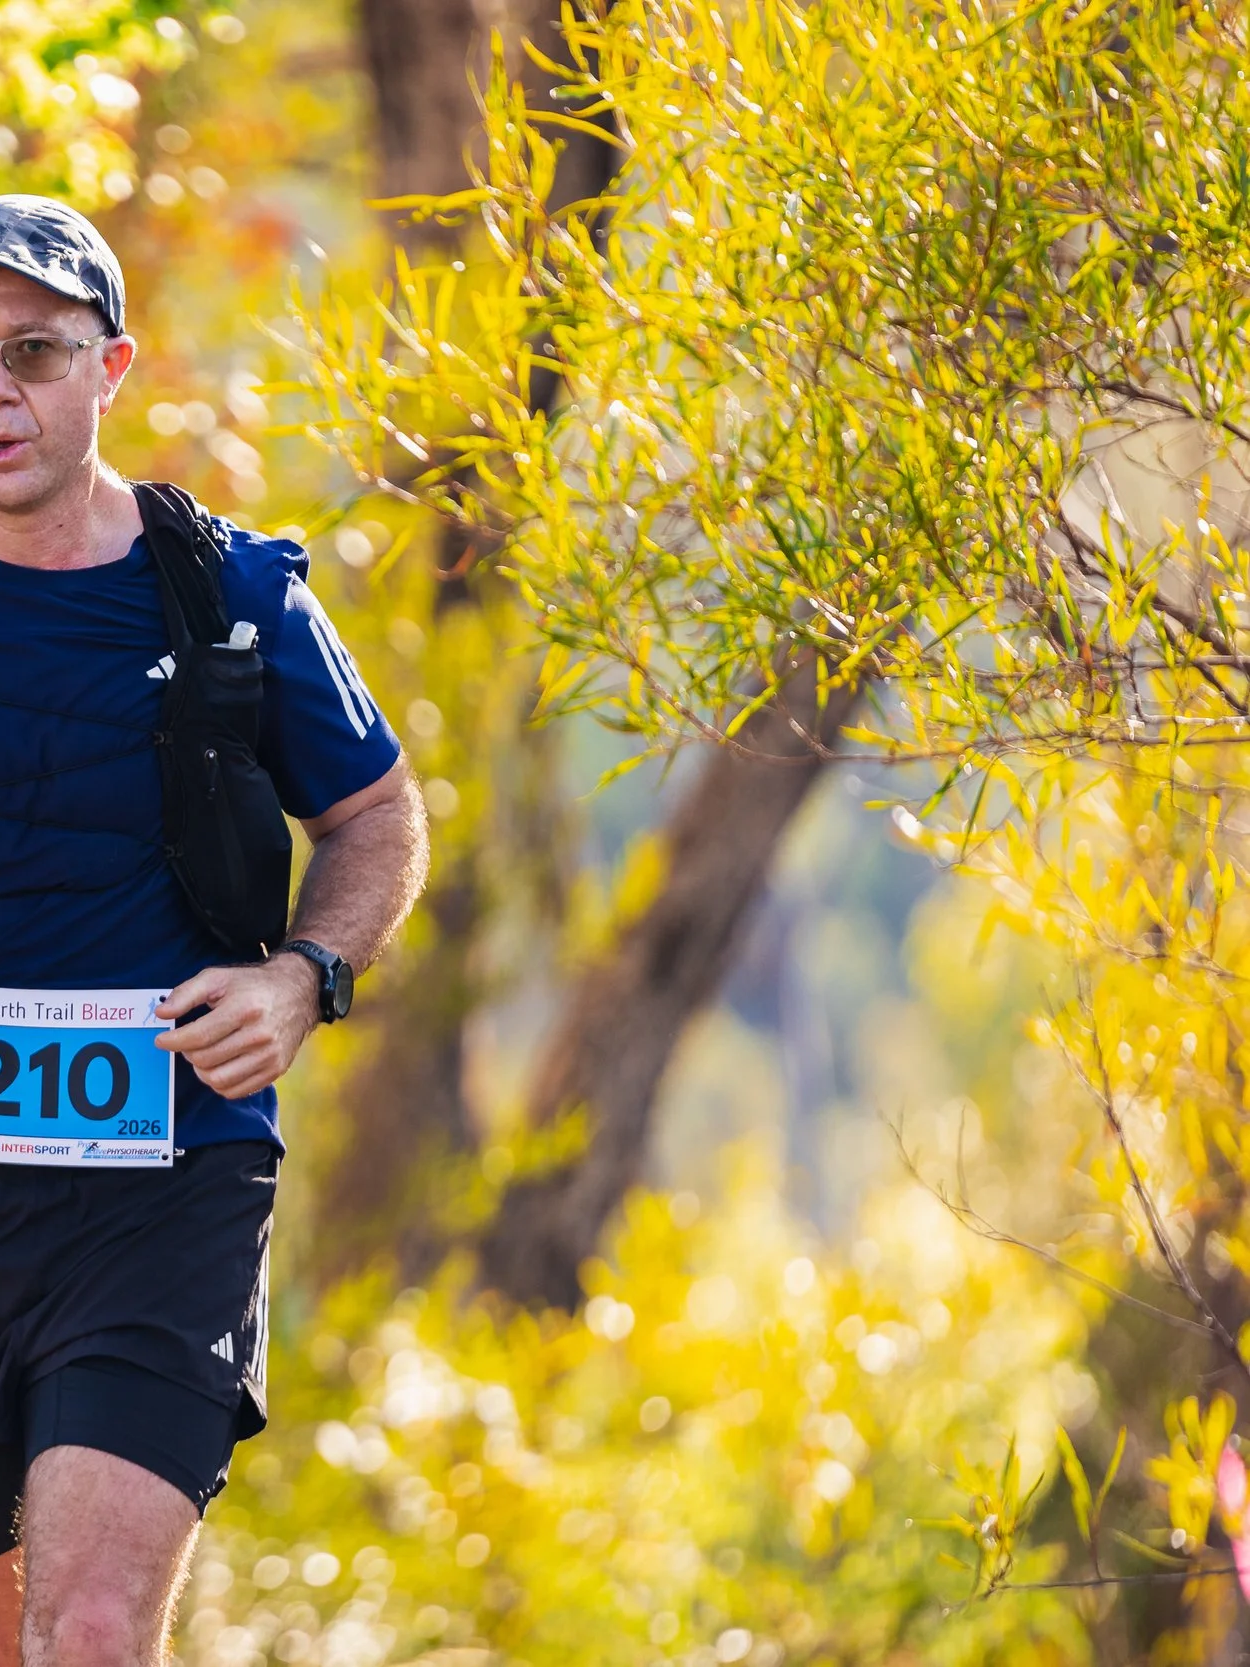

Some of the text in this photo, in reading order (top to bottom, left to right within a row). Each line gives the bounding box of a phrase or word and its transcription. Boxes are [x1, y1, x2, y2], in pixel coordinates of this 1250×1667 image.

[34, 1002, 74, 1020] Trail
[82, 1002, 135, 1020] Blazer
[117, 1119, 161, 1136] 2026
[1, 1143, 71, 1155] INTERSPORT
